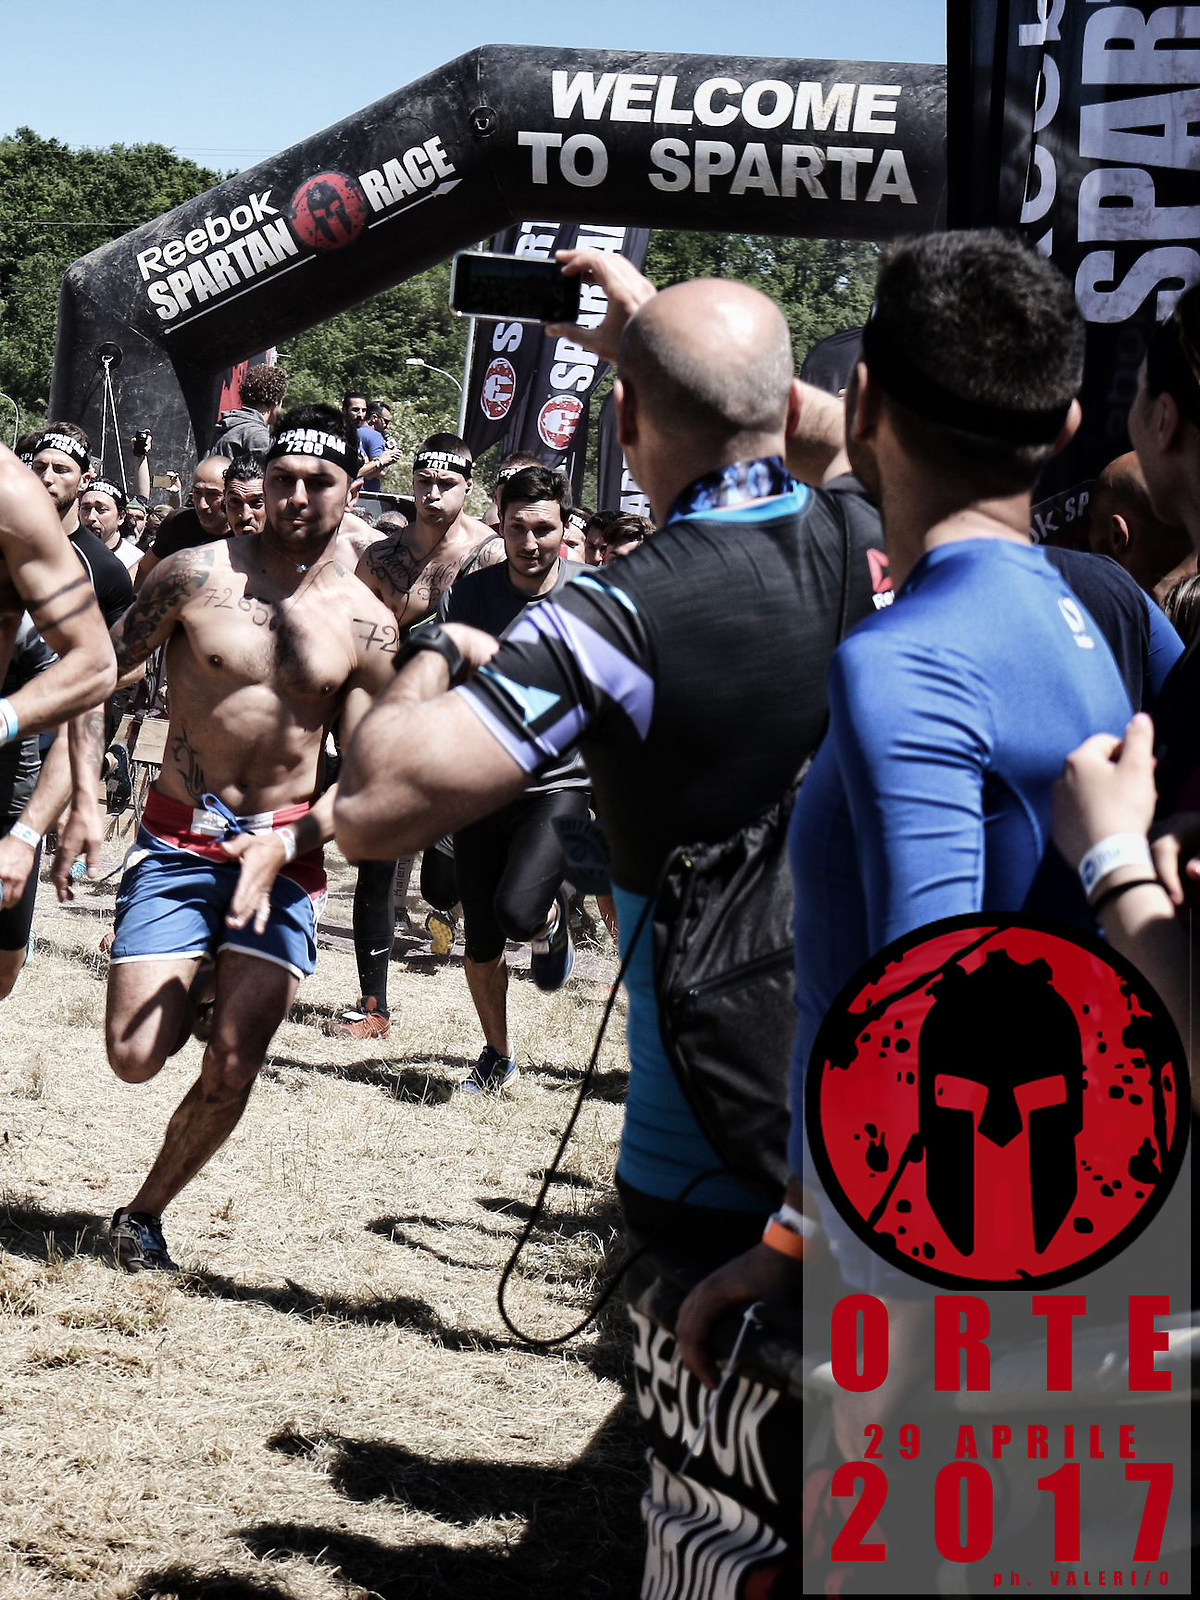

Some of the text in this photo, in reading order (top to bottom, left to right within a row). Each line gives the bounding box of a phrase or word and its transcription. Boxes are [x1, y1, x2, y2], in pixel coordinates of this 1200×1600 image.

[552, 70, 902, 134] WELCOME
[518, 131, 918, 204] TO SPARTA
[136, 189, 279, 281] Reebok
[147, 135, 457, 320] SPARTAN RACE
[278, 428, 346, 455] SPARTAN
[285, 440, 324, 456] 7265
[418, 451, 467, 467] SPARTAN
